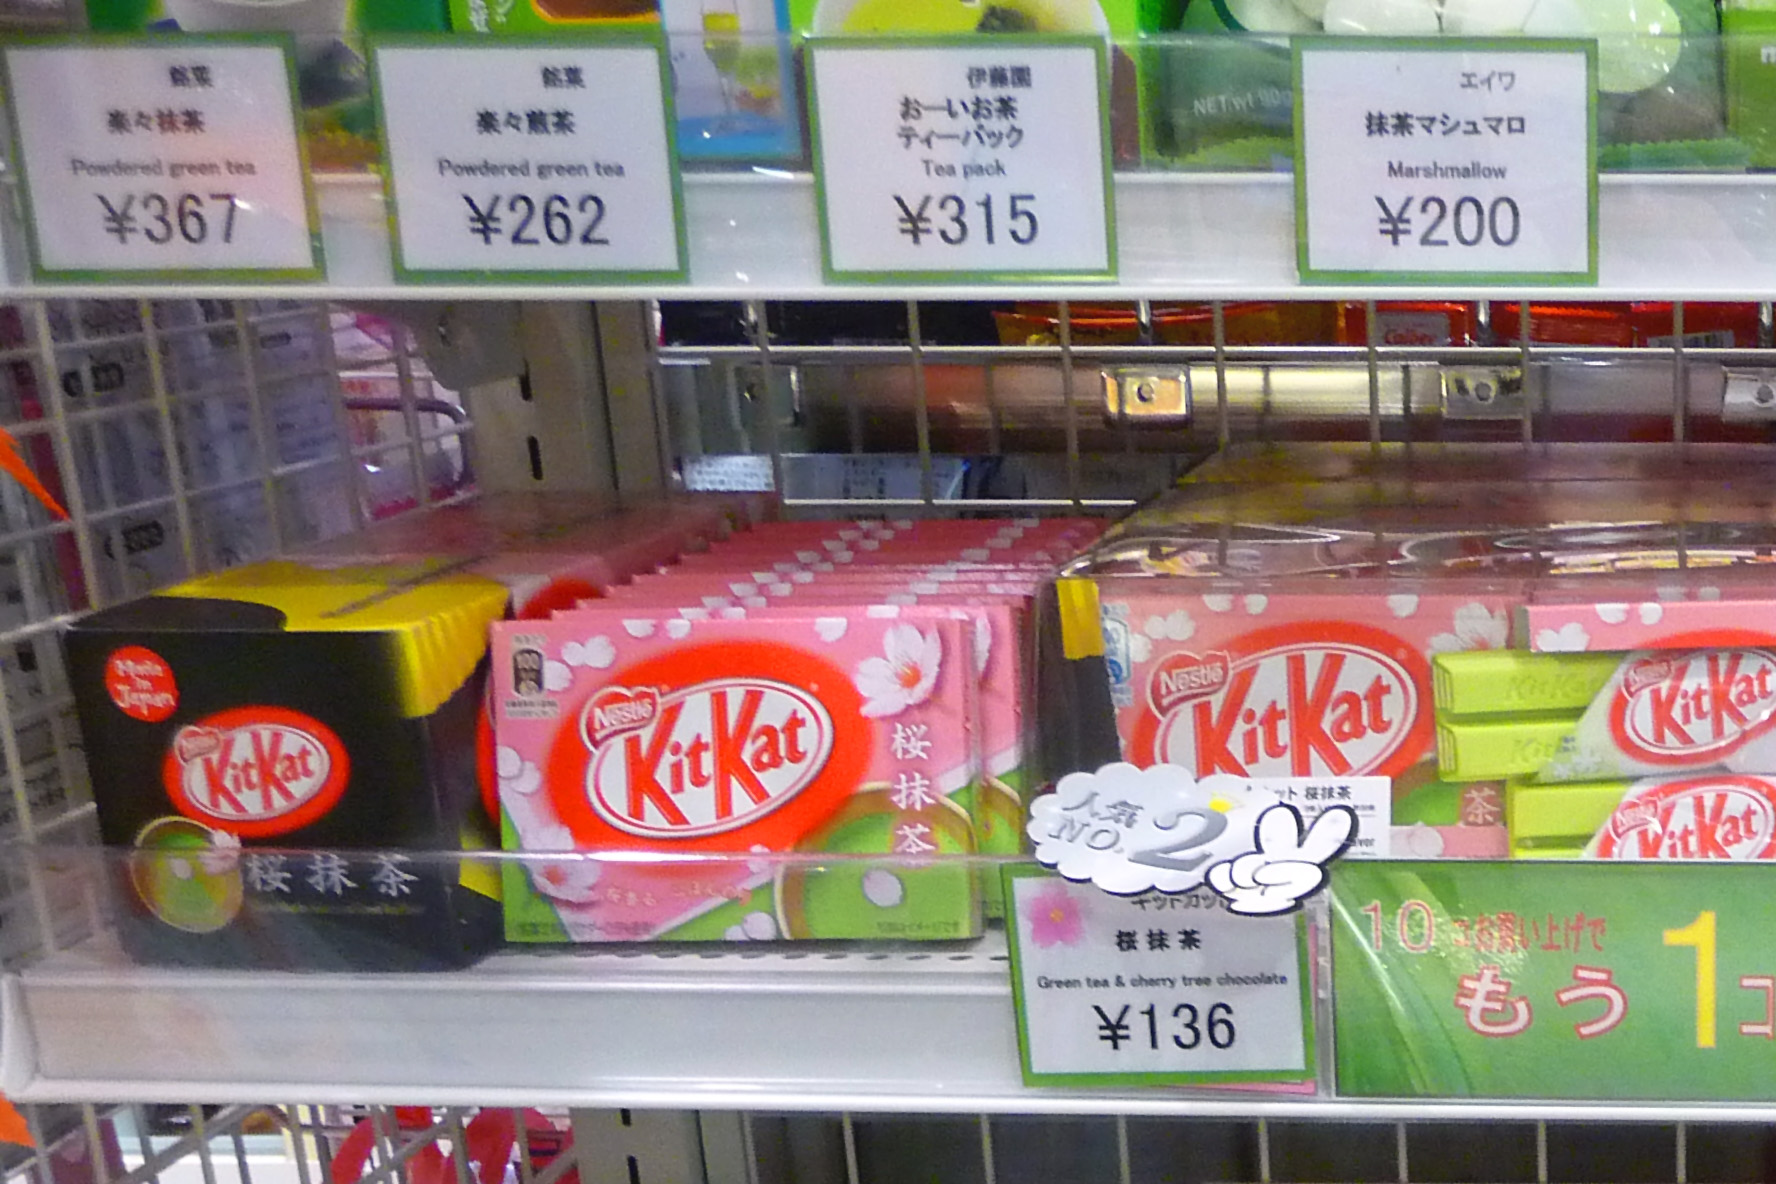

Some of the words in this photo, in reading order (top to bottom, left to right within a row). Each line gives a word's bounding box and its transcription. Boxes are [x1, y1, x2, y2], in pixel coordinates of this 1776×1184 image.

[967, 65, 1032, 88] 伊藤園
[1460, 71, 1516, 91] エイワ
[900, 96, 1018, 121] おーいお茶
[1365, 111, 1526, 137] 抹茶マシュマロ
[71, 157, 163, 178] Powdered
[168, 160, 217, 180] green
[225, 159, 256, 176] tea
[438, 158, 531, 178] Powdered
[536, 161, 586, 181] green
[594, 160, 625, 177] tea
[922, 158, 956, 177] Tea
[962, 158, 1006, 181] pack
[1387, 160, 1507, 180] Marshmallow
[96, 192, 239, 246] ¥367
[461, 194, 610, 246] ¥262
[893, 193, 1038, 245] ¥315
[1374, 195, 1521, 247] ¥200
[1193, 653, 1393, 778] KitKat
[1651, 653, 1774, 748] KitKat
[203, 728, 316, 814] KitKat
[623, 690, 809, 827] KitKat
[890, 721, 936, 856] 桜抹茶
[1062, 791, 1145, 829] 人気
[1128, 808, 1228, 872] 2
[245, 853, 419, 897] 桜抹茶
[1115, 929, 1202, 951] 桜抹茶
[1037, 976, 1081, 990] Green
[1086, 977, 1109, 990] tea
[1114, 975, 1127, 989] &
[1129, 975, 1176, 991] cherry
[1182, 975, 1212, 988] tree
[1216, 973, 1288, 987] chocolate
[1091, 1002, 1237, 1050] ¥136
